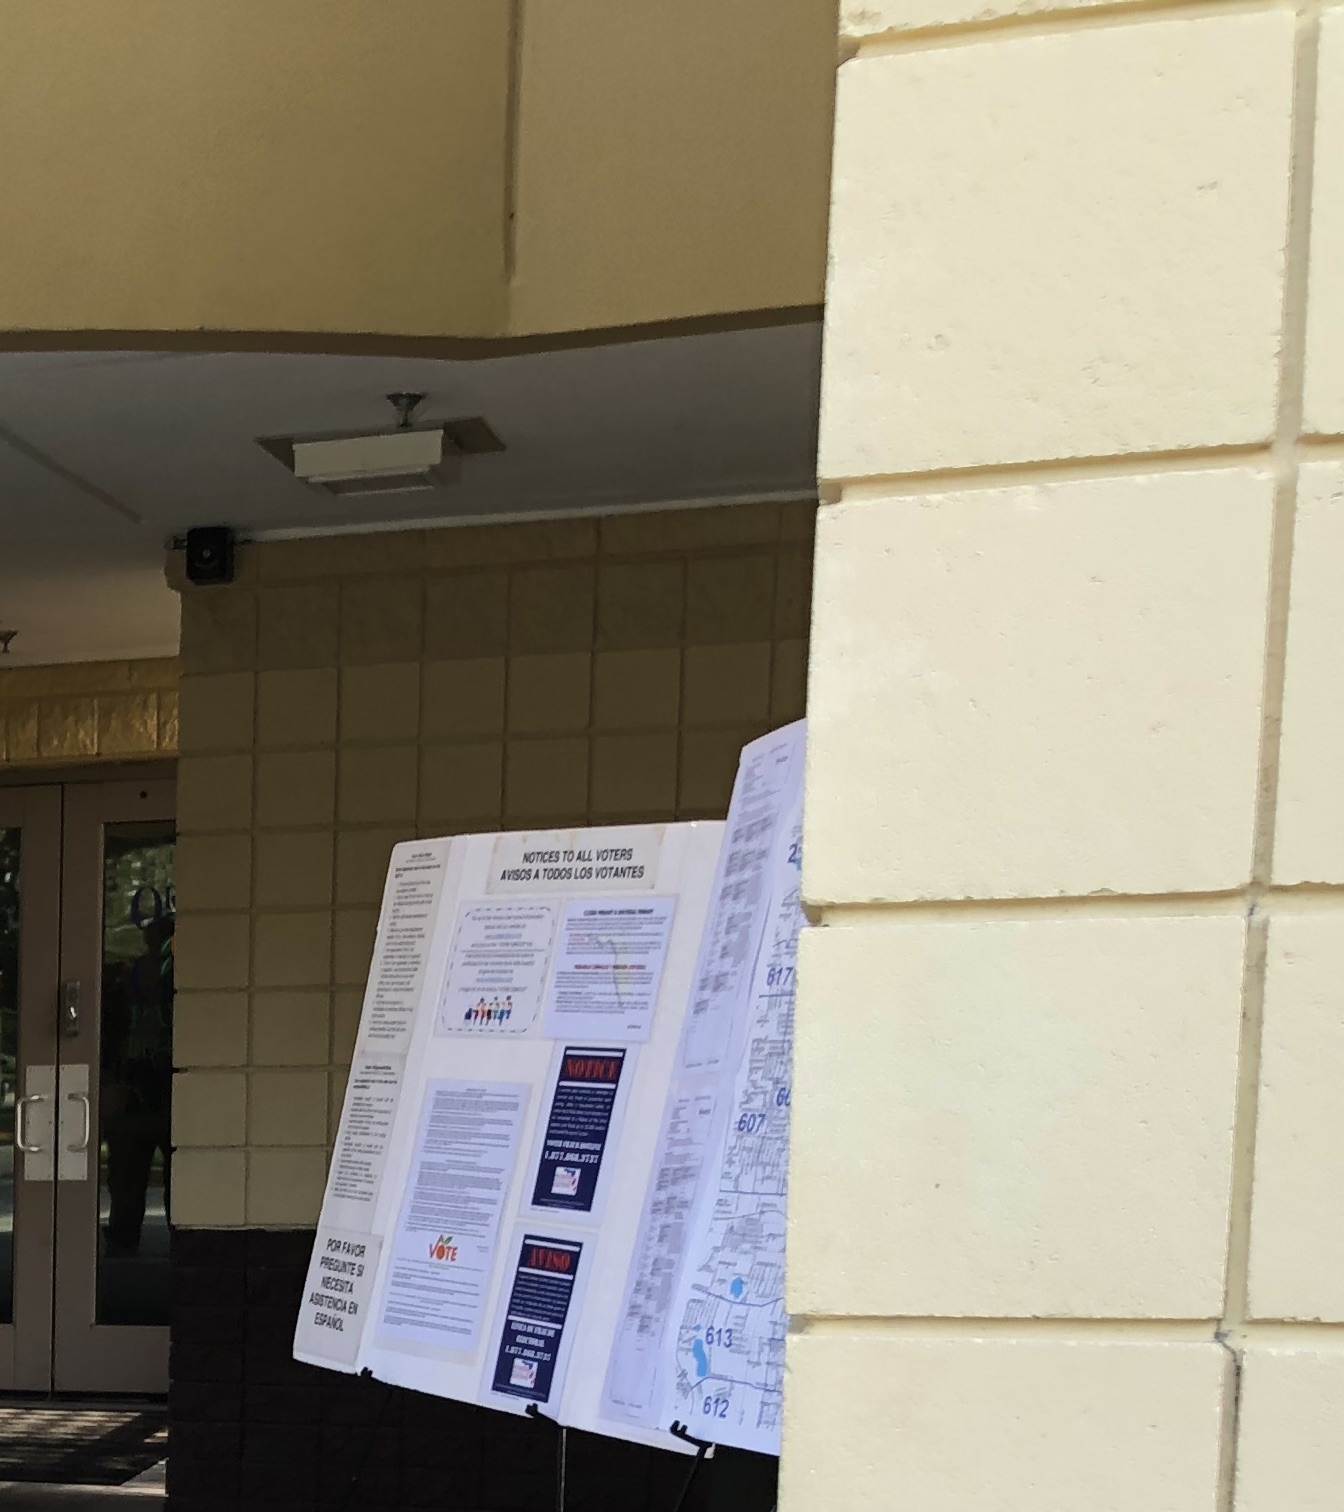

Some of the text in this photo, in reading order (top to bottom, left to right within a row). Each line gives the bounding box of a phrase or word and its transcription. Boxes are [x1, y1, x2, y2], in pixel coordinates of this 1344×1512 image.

[522, 848, 633, 864] NOTICES TO ALL VOTERS
[500, 865, 645, 881] AVISOS A TODOS LOS VOTANTES
[766, 966, 793, 986] 617
[738, 1113, 766, 1133] 607
[326, 1238, 366, 1258] POR FAVOR
[429, 1234, 458, 1262] VOTE
[348, 1301, 359, 1315] EN
[705, 1325, 733, 1349] 613
[703, 1395, 730, 1419] 612
